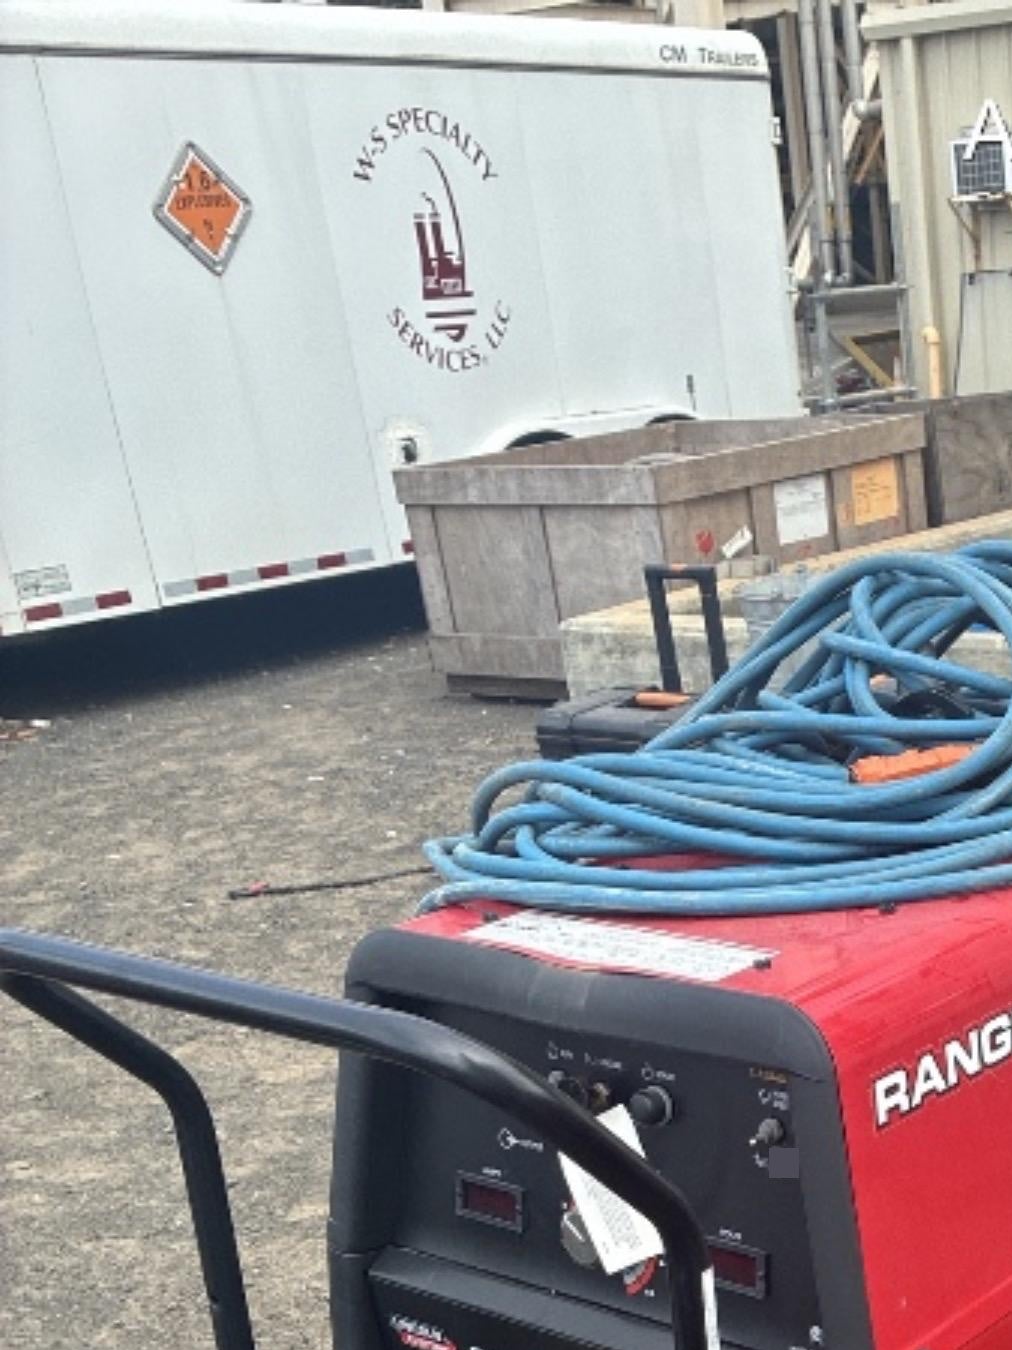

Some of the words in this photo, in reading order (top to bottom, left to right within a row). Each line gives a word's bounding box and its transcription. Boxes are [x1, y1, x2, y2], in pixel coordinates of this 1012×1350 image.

[659, 45, 688, 63] CM
[386, 107, 499, 181] SPECIALTY
[485, 300, 511, 349] LLC
